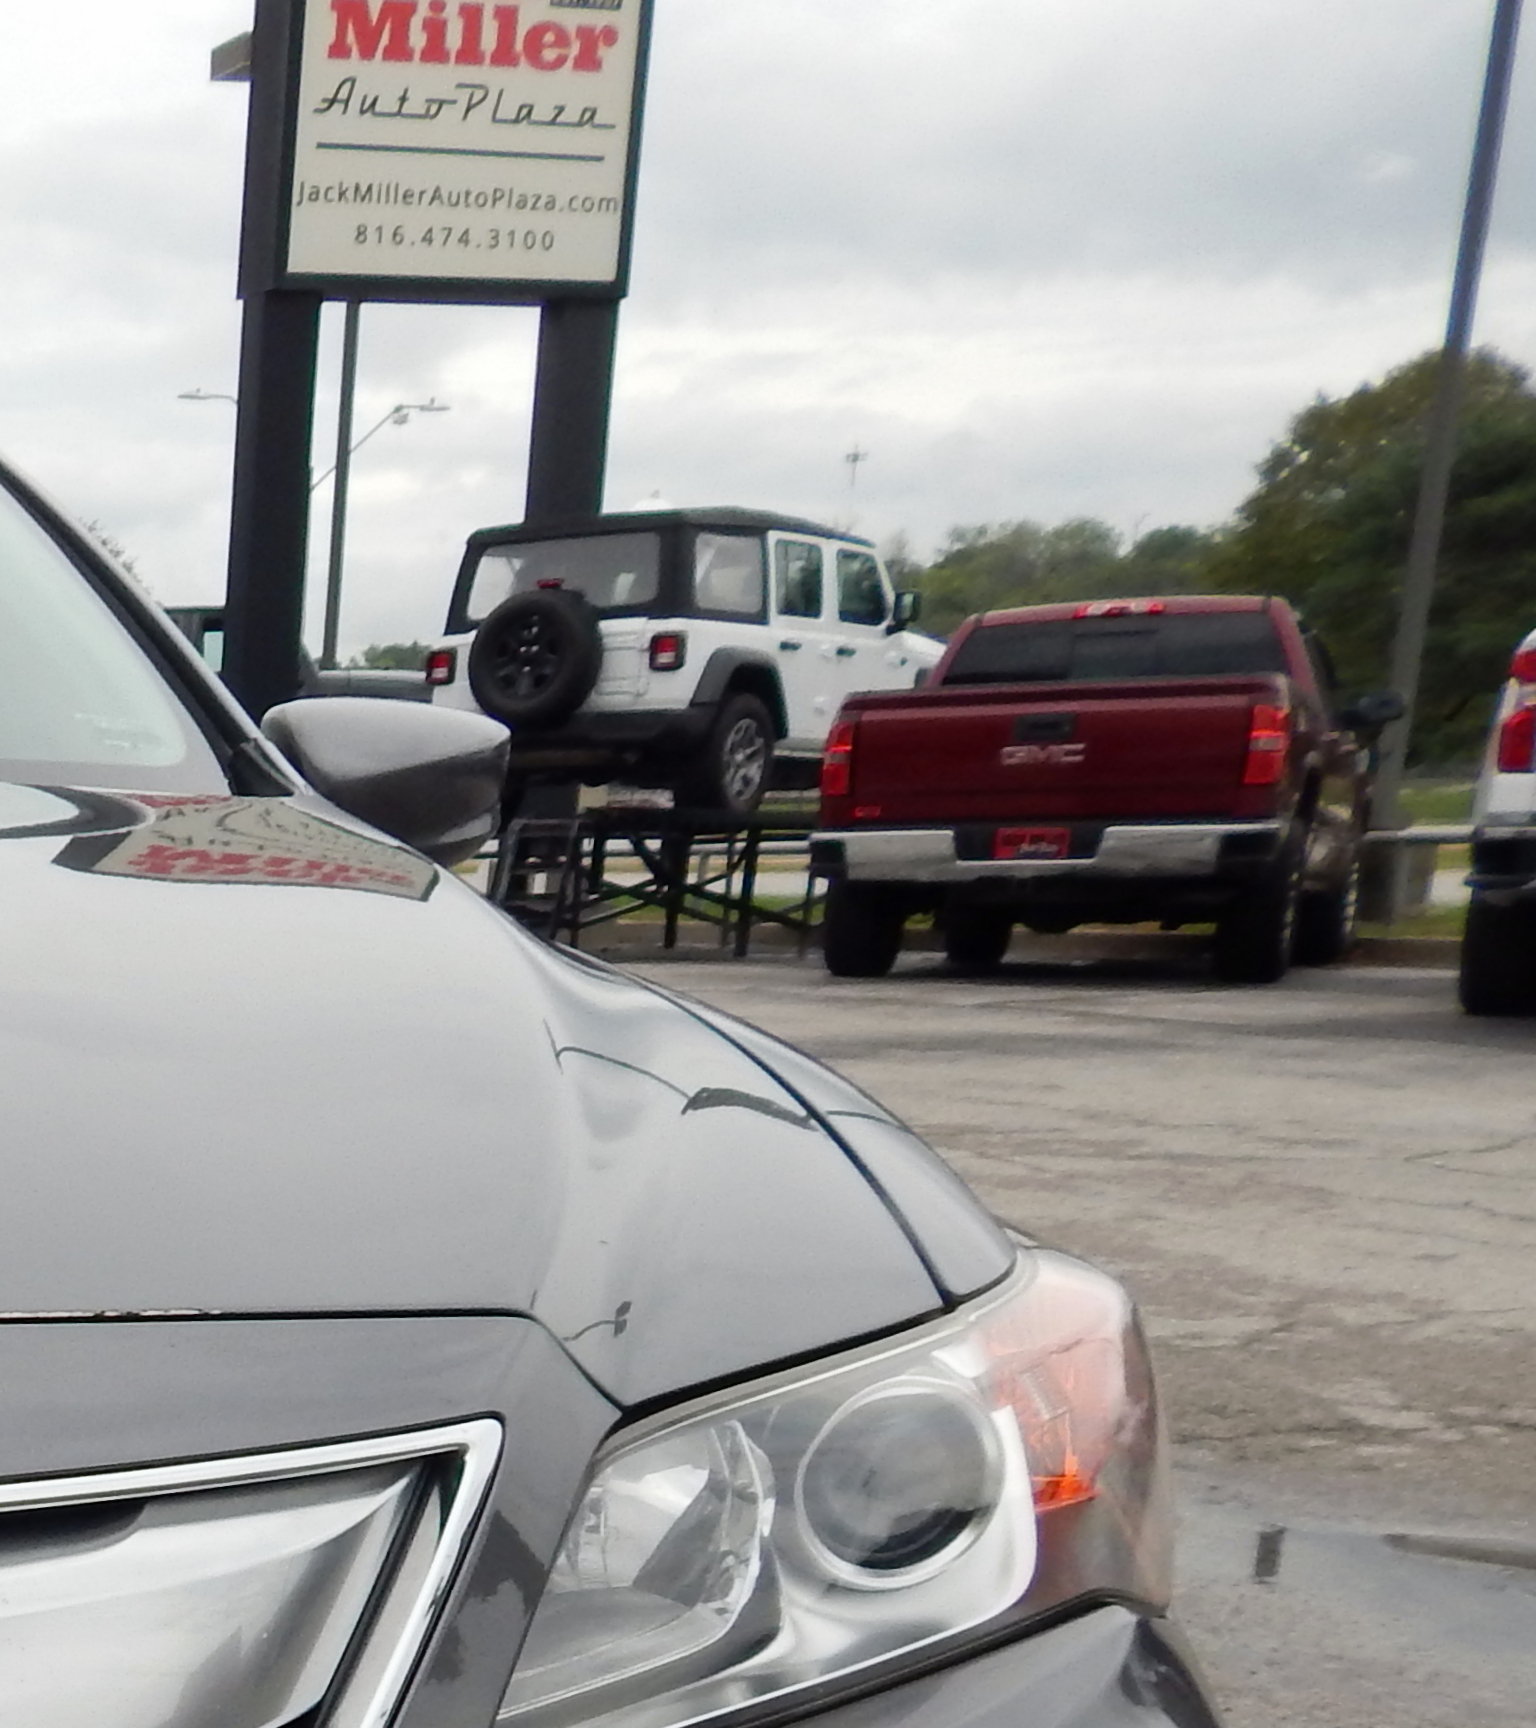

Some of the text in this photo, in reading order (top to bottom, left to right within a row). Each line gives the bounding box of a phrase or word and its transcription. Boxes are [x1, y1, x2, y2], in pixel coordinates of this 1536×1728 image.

[327, 0, 619, 72] Miller
[295, 180, 619, 213] JackMillerAutoPlaza.com
[354, 223, 555, 251] 816.474.3100
